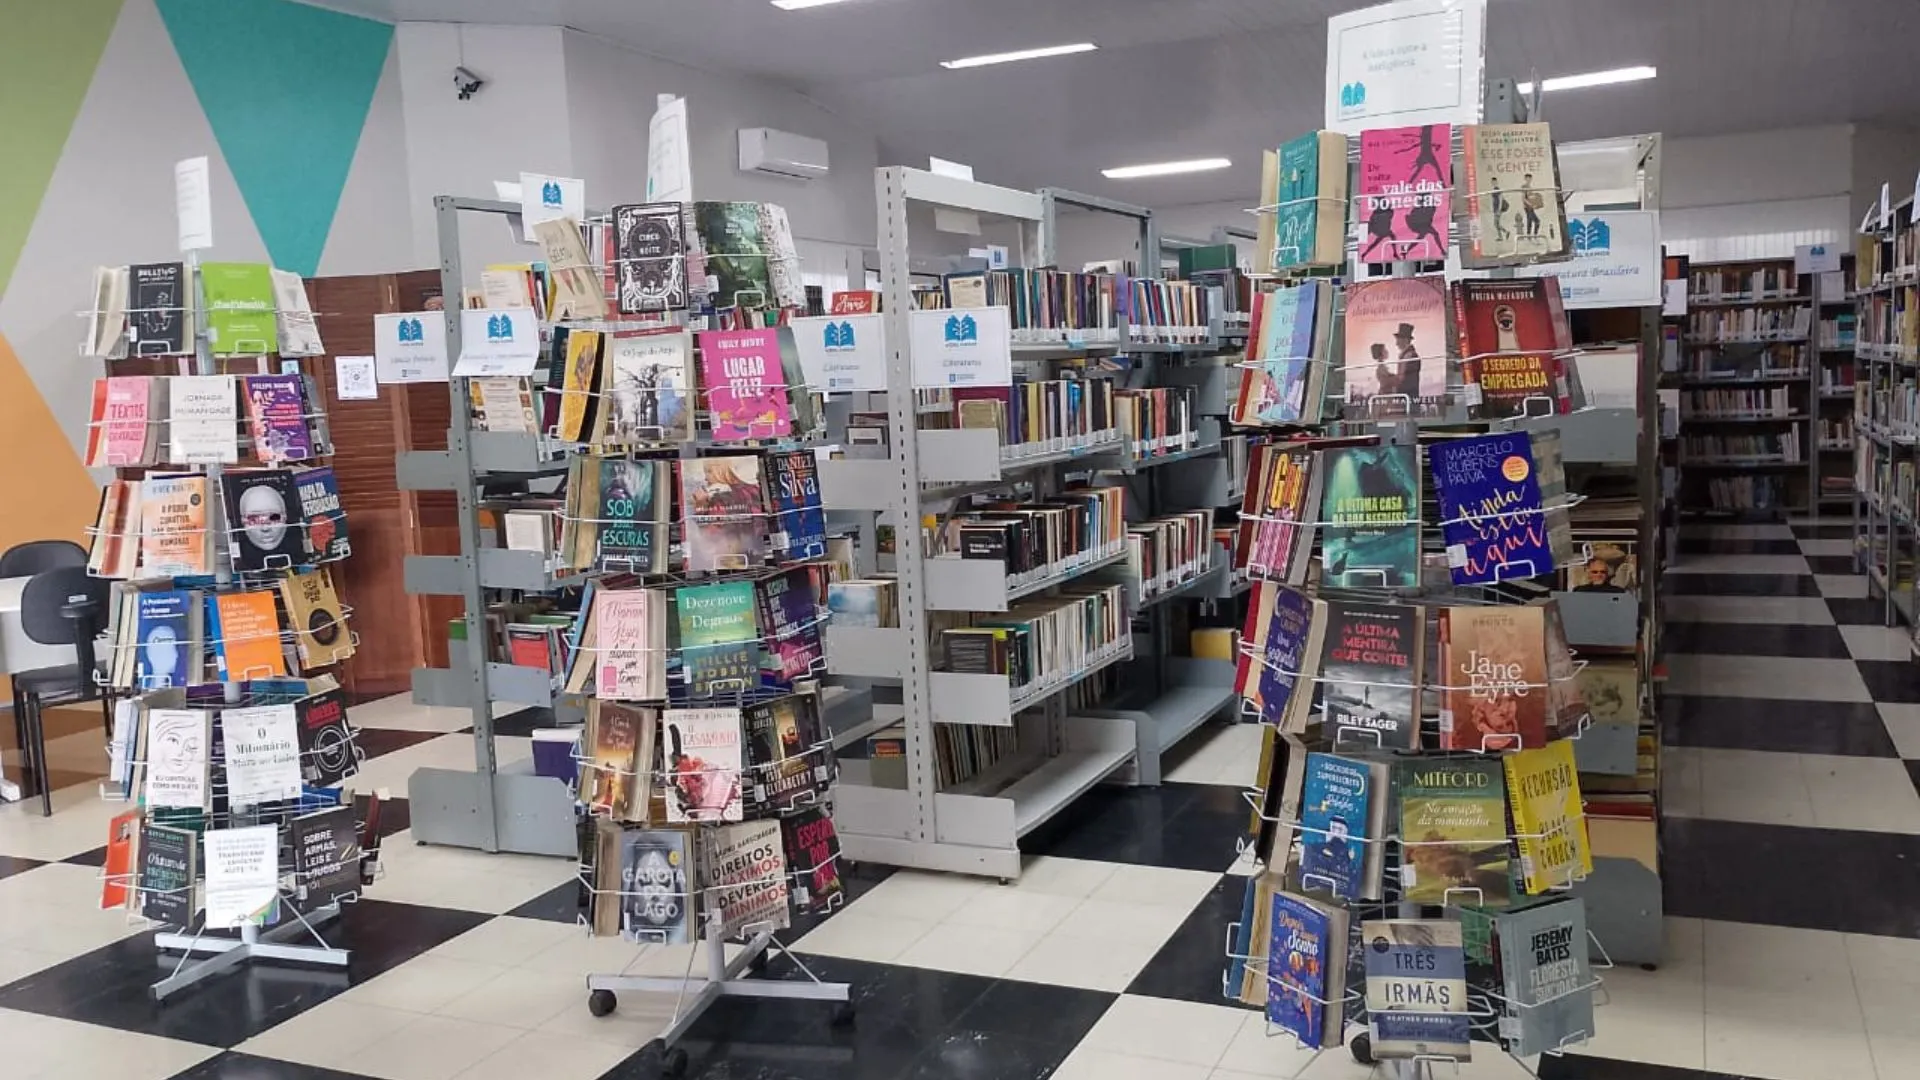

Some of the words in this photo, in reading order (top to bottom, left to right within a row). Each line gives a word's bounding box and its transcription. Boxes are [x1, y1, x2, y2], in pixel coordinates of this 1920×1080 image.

[1507, 147, 1545, 159] FOSSE
[1382, 179, 1413, 195] vale
[1416, 178, 1443, 192] das
[1367, 193, 1443, 211] bonecas
[723, 356, 765, 378] LUGAR
[1489, 358, 1527, 371] SEGREDO
[1528, 357, 1541, 370] DA
[730, 376, 765, 398] FELIZ
[1480, 371, 1549, 390] EMPREGADA
[1445, 440, 1513, 460] MARCELO
[777, 454, 815, 471] DANIEL
[1446, 454, 1499, 473] RUBENS
[780, 468, 817, 498] Silva
[1448, 469, 1487, 486] PAIVA
[607, 499, 634, 517] SOB
[602, 531, 649, 547] ESCURAS
[685, 594, 747, 610] Dezenove
[692, 613, 744, 631] Degraus
[1355, 620, 1400, 639] ÚLTIMA
[1342, 637, 1398, 651] MENTIRA
[1331, 648, 1360, 662] QUE
[1362, 650, 1408, 667] CONTEI
[1460, 649, 1523, 681] Jane
[1468, 673, 1530, 705] Eyre
[1336, 713, 1364, 727] RILEY
[1365, 715, 1399, 731] SAGER
[257, 727, 266, 739] O
[683, 731, 738, 745] CASAMENTO
[1413, 771, 1489, 788] MITFORD
[1520, 763, 1573, 800] RECURSÃO
[303, 830, 333, 845] SOBRE
[305, 856, 324, 869] LEIS
[648, 852, 661, 866] A
[712, 844, 773, 882] DIREITOS
[622, 869, 687, 883] GAROTA
[718, 873, 777, 909] DEVERES
[634, 901, 679, 918] LAGO
[723, 886, 788, 921] MÍNIMOS
[1530, 926, 1573, 952] JEREMY
[1393, 947, 1436, 972] TRÊS
[1536, 943, 1570, 966] BATES
[1385, 981, 1451, 1005] IRMÃS
